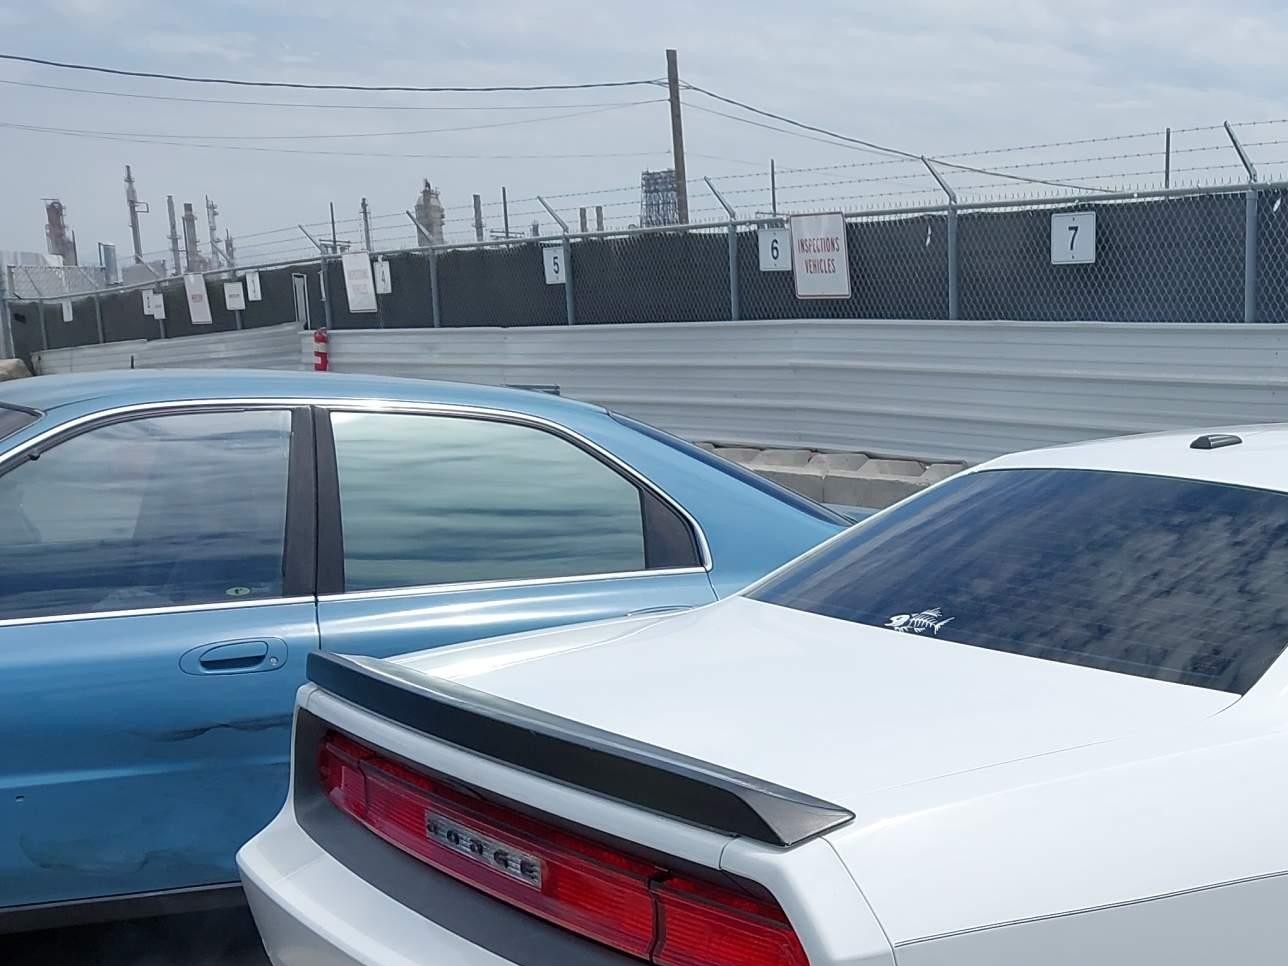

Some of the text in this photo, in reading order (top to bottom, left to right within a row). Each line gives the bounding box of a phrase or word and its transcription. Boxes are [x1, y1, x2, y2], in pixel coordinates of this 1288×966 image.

[797, 236, 840, 254] INSPECTIONS
[1067, 225, 1079, 251] 7
[770, 239, 780, 260] 6
[552, 255, 560, 275] 5
[804, 258, 836, 275] VEHICLES
